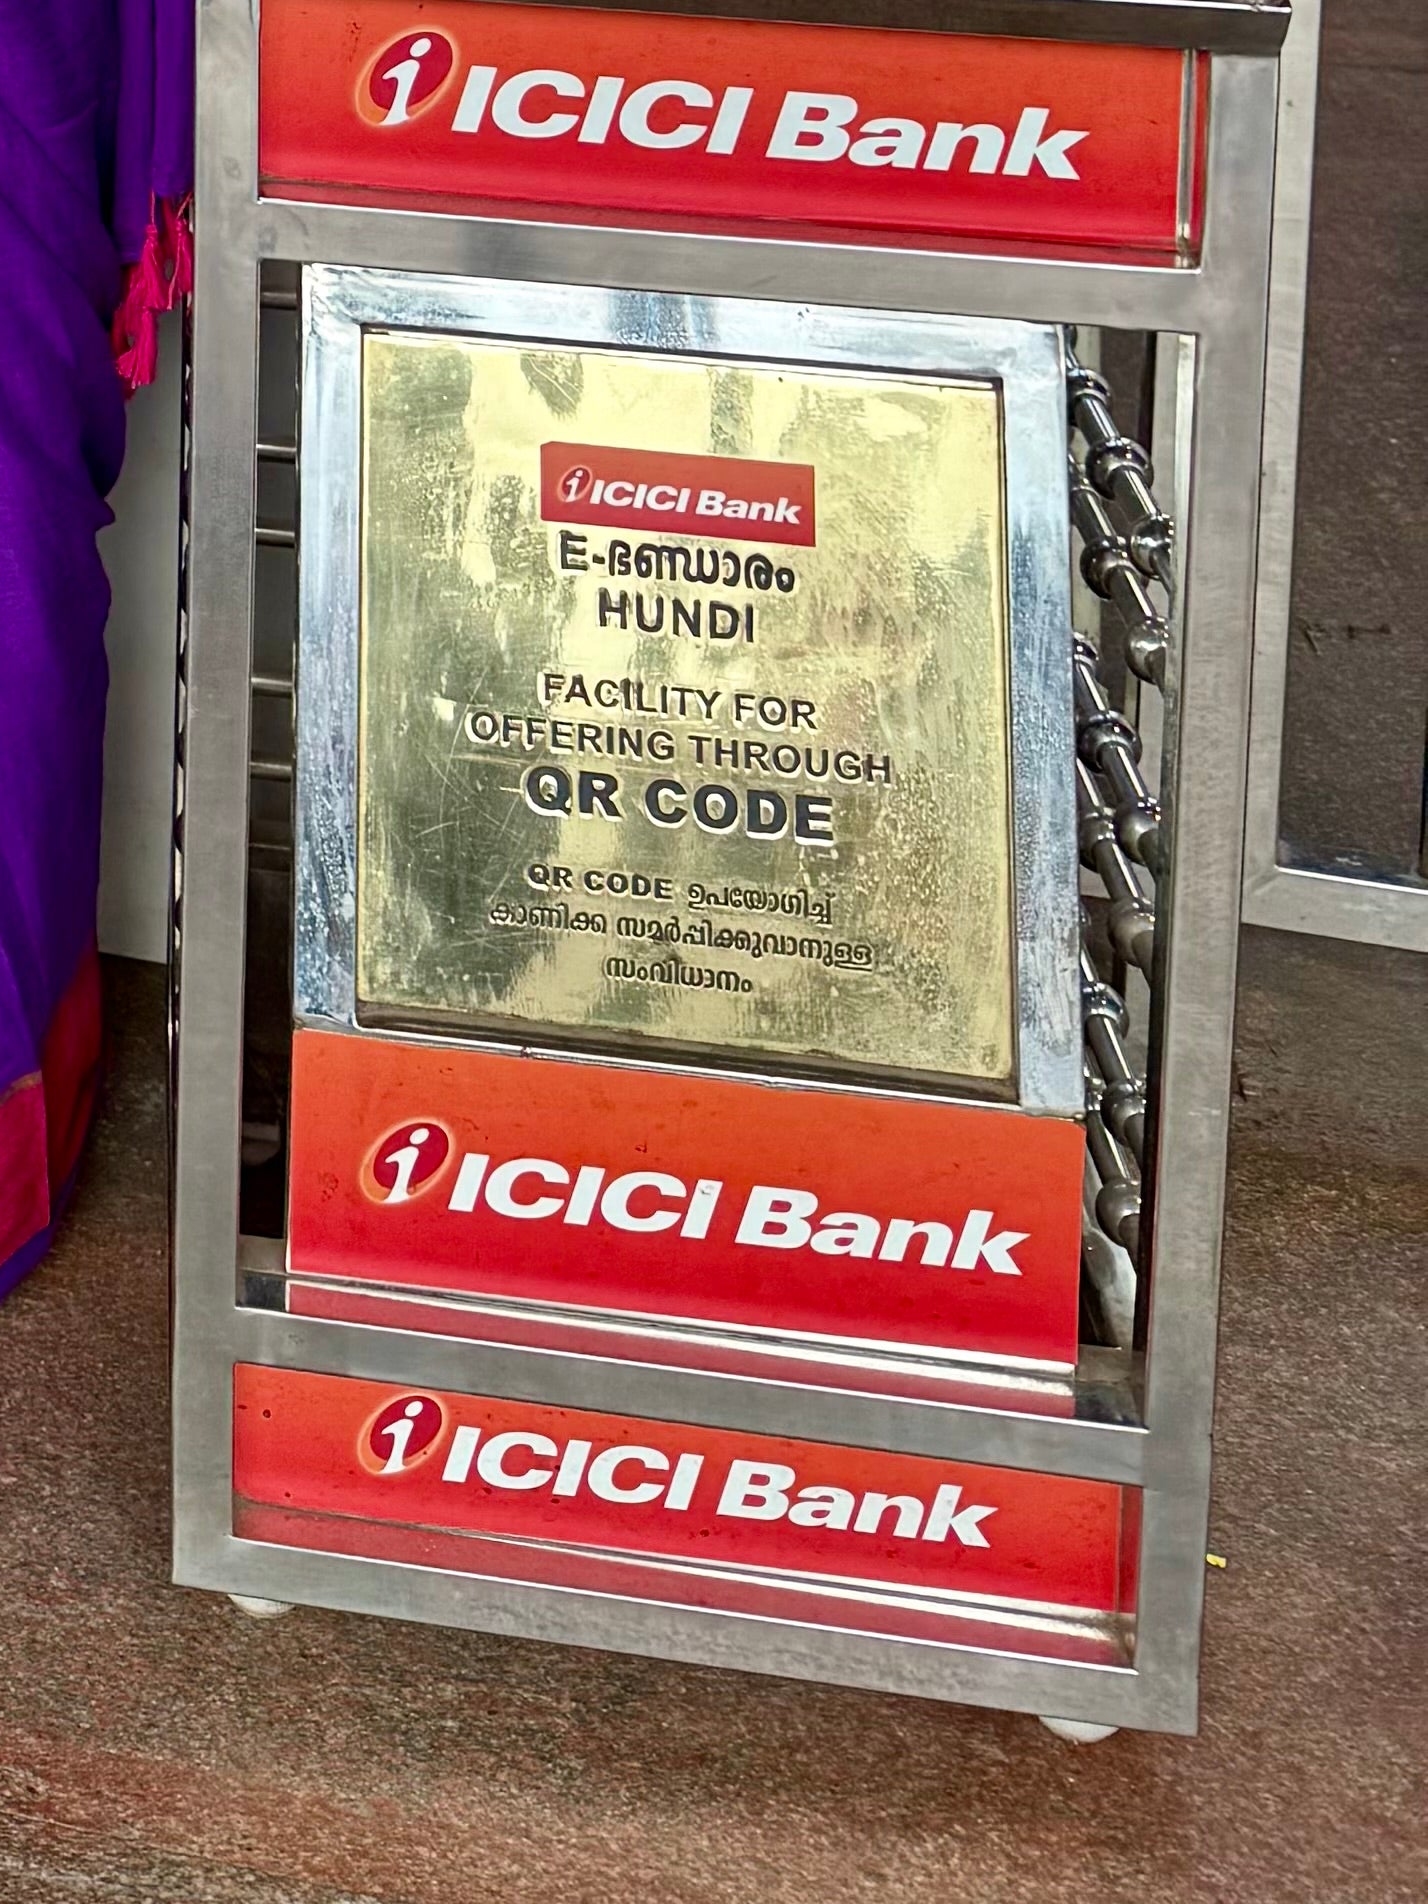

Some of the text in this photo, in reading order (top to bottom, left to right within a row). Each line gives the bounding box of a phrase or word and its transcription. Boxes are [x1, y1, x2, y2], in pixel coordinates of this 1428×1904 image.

[452, 65, 754, 155] ICICI
[765, 91, 1090, 180] Bank
[590, 479, 691, 514] ICICI
[695, 489, 801, 525] Bank
[598, 588, 755, 644] HUNDI
[542, 673, 817, 730] FACILITY FOR
[468, 711, 891, 784] OFFERING THROUGH
[524, 767, 834, 841] QR CODE
[528, 865, 573, 889] QR
[583, 873, 674, 900] CODE
[448, 1154, 722, 1239] ICICI
[735, 1185, 1031, 1276] Bank
[442, 1426, 703, 1512] ICICI
[717, 1459, 998, 1549] Bank
